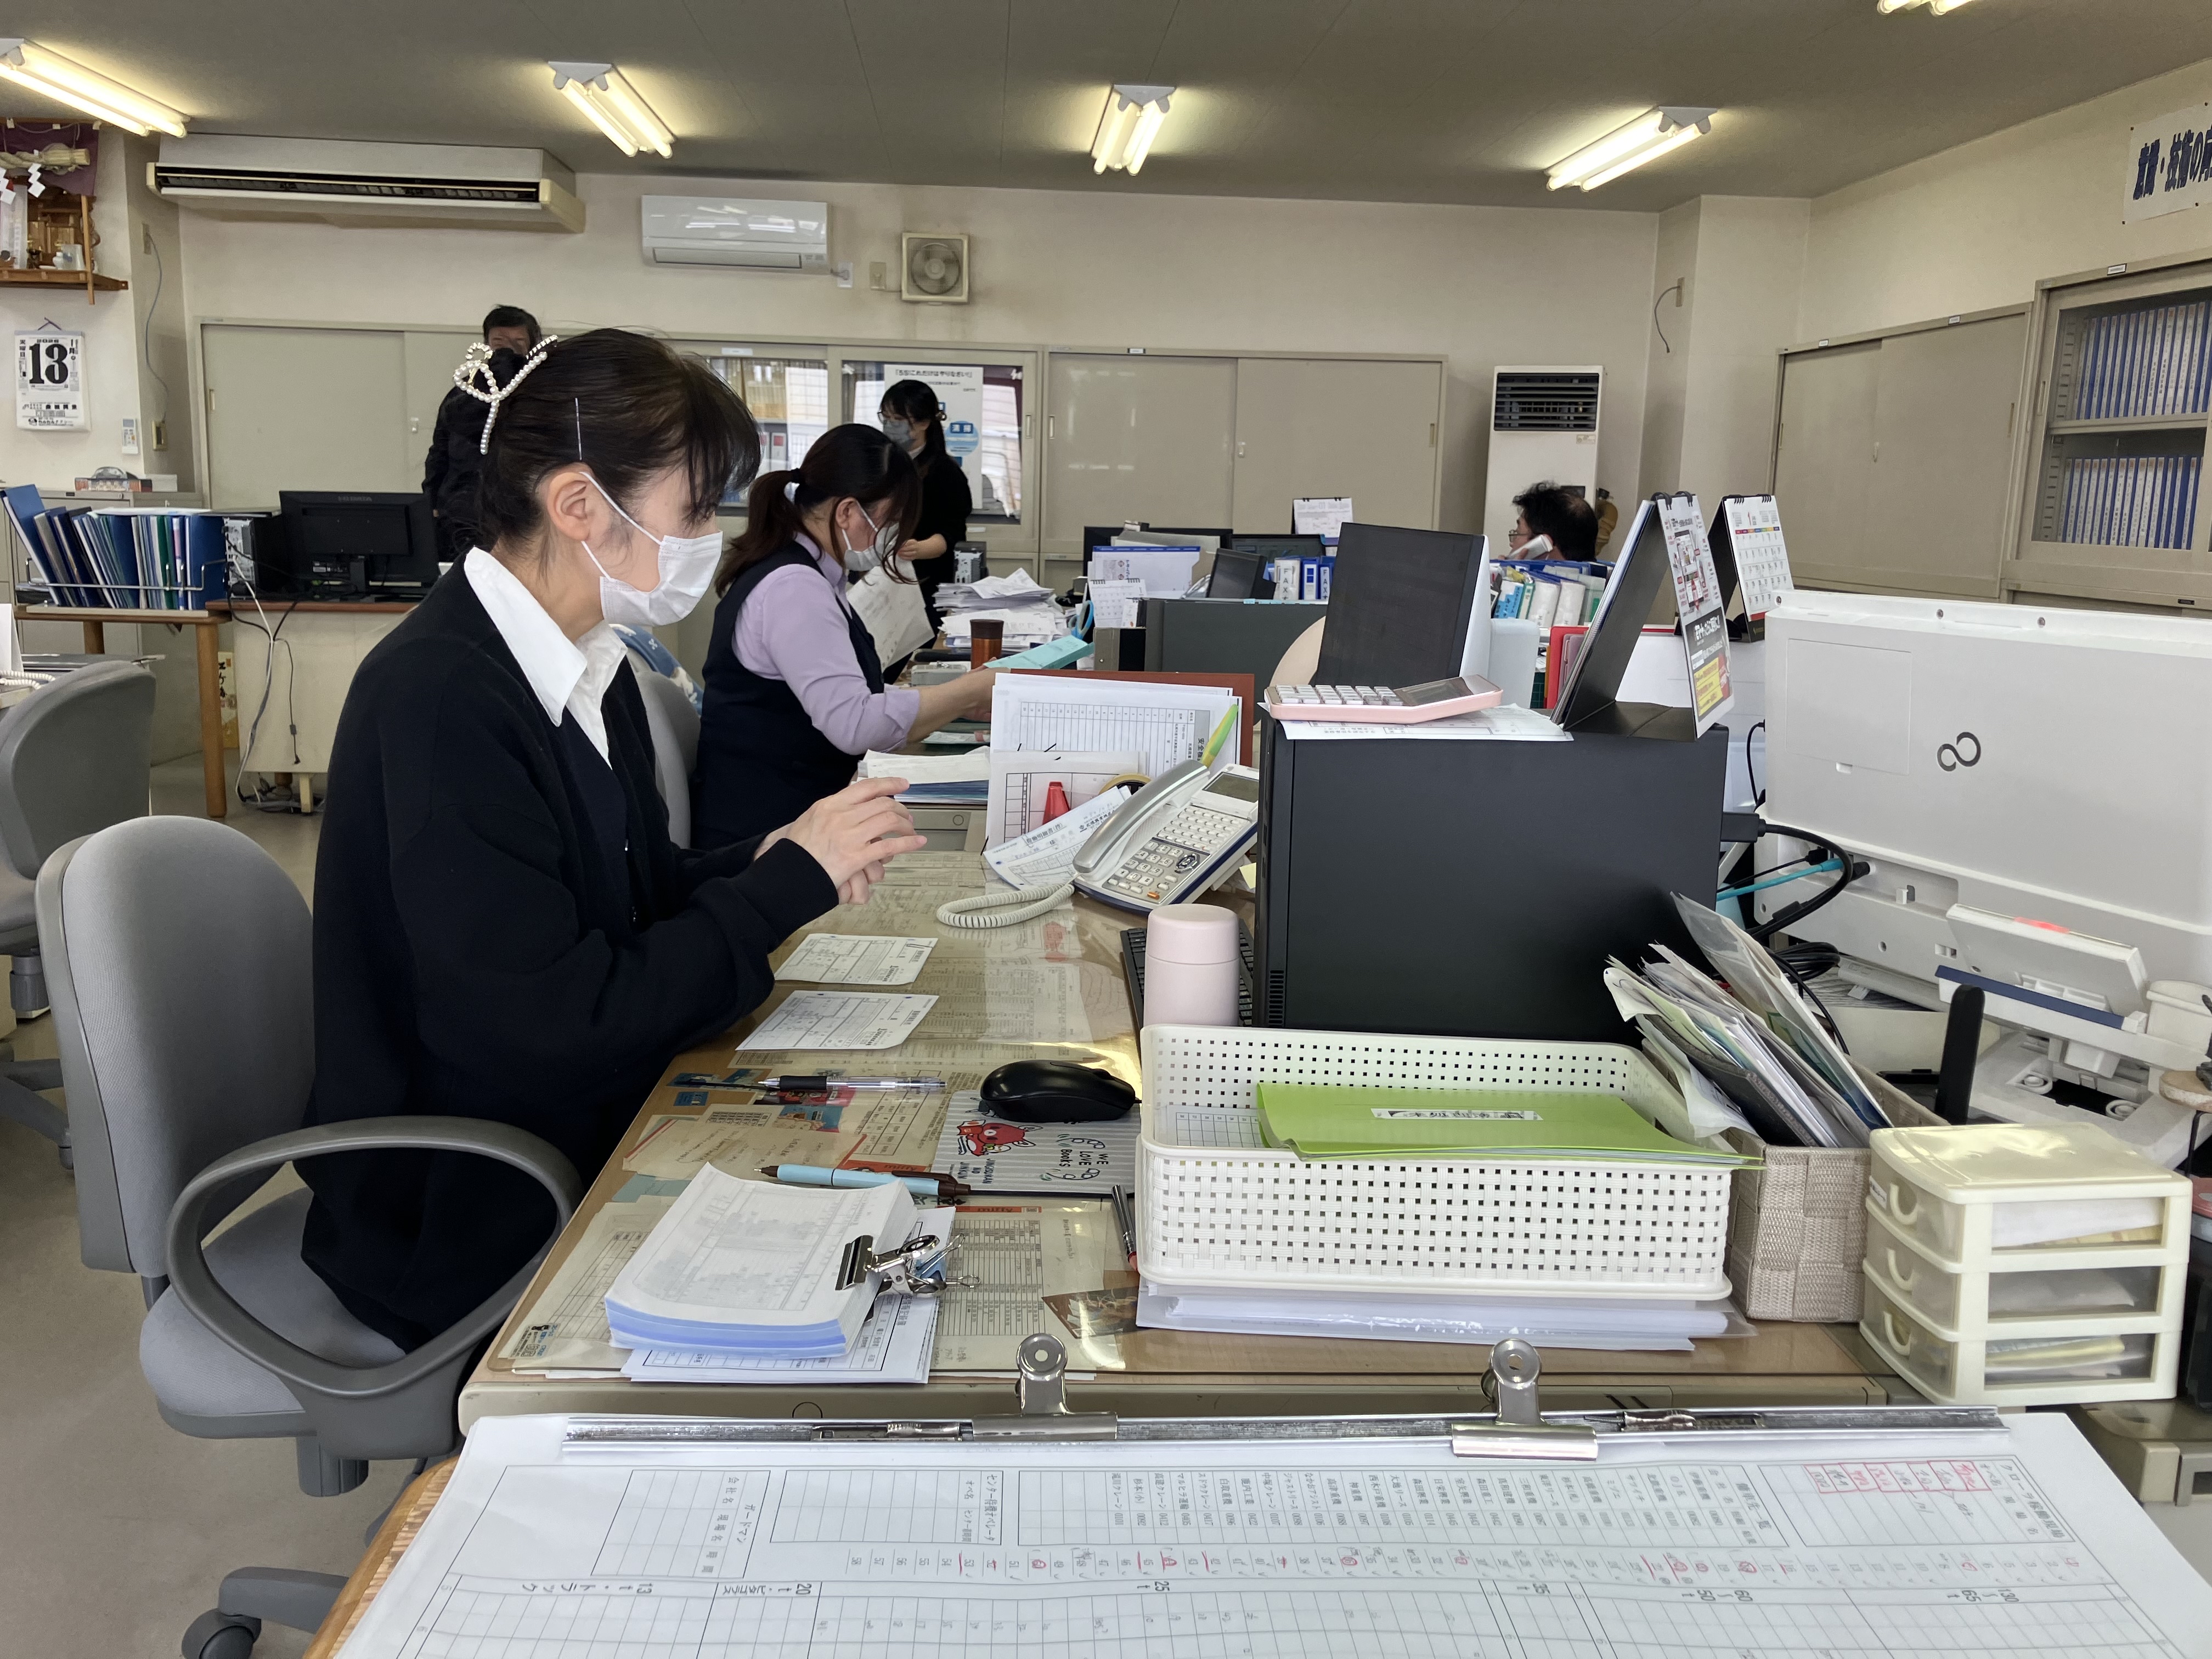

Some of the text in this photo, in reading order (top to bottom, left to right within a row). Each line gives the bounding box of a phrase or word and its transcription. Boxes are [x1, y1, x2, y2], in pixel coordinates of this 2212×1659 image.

[29, 343, 68, 384] 13
[1079, 1151, 1093, 1166] LOVE
[1096, 1153, 1109, 1165] WE
[723, 1476, 740, 1504] 会社名
[1177, 1472, 1189, 1510] マルヒラ運輸
[1198, 1472, 1214, 1526] スドウクレーン 0417
[1284, 1472, 1299, 1510] ジャストリース
[1326, 1478, 1342, 1505] 高津重機
[1390, 1475, 1407, 1507] 大地リース
[1412, 1478, 1429, 1505] 森田興業
[1476, 1478, 1493, 1504] 森田重工
[710, 1514, 729, 1542] 現場名
[737, 1504, 755, 1544] ガードマン
[1115, 1513, 1124, 1525] 0101
[1159, 1513, 1169, 1526] 0412
[1225, 1513, 1235, 1525] 0096
[1248, 1513, 1258, 1526] 0422
[1269, 1513, 1280, 1526] 0107
